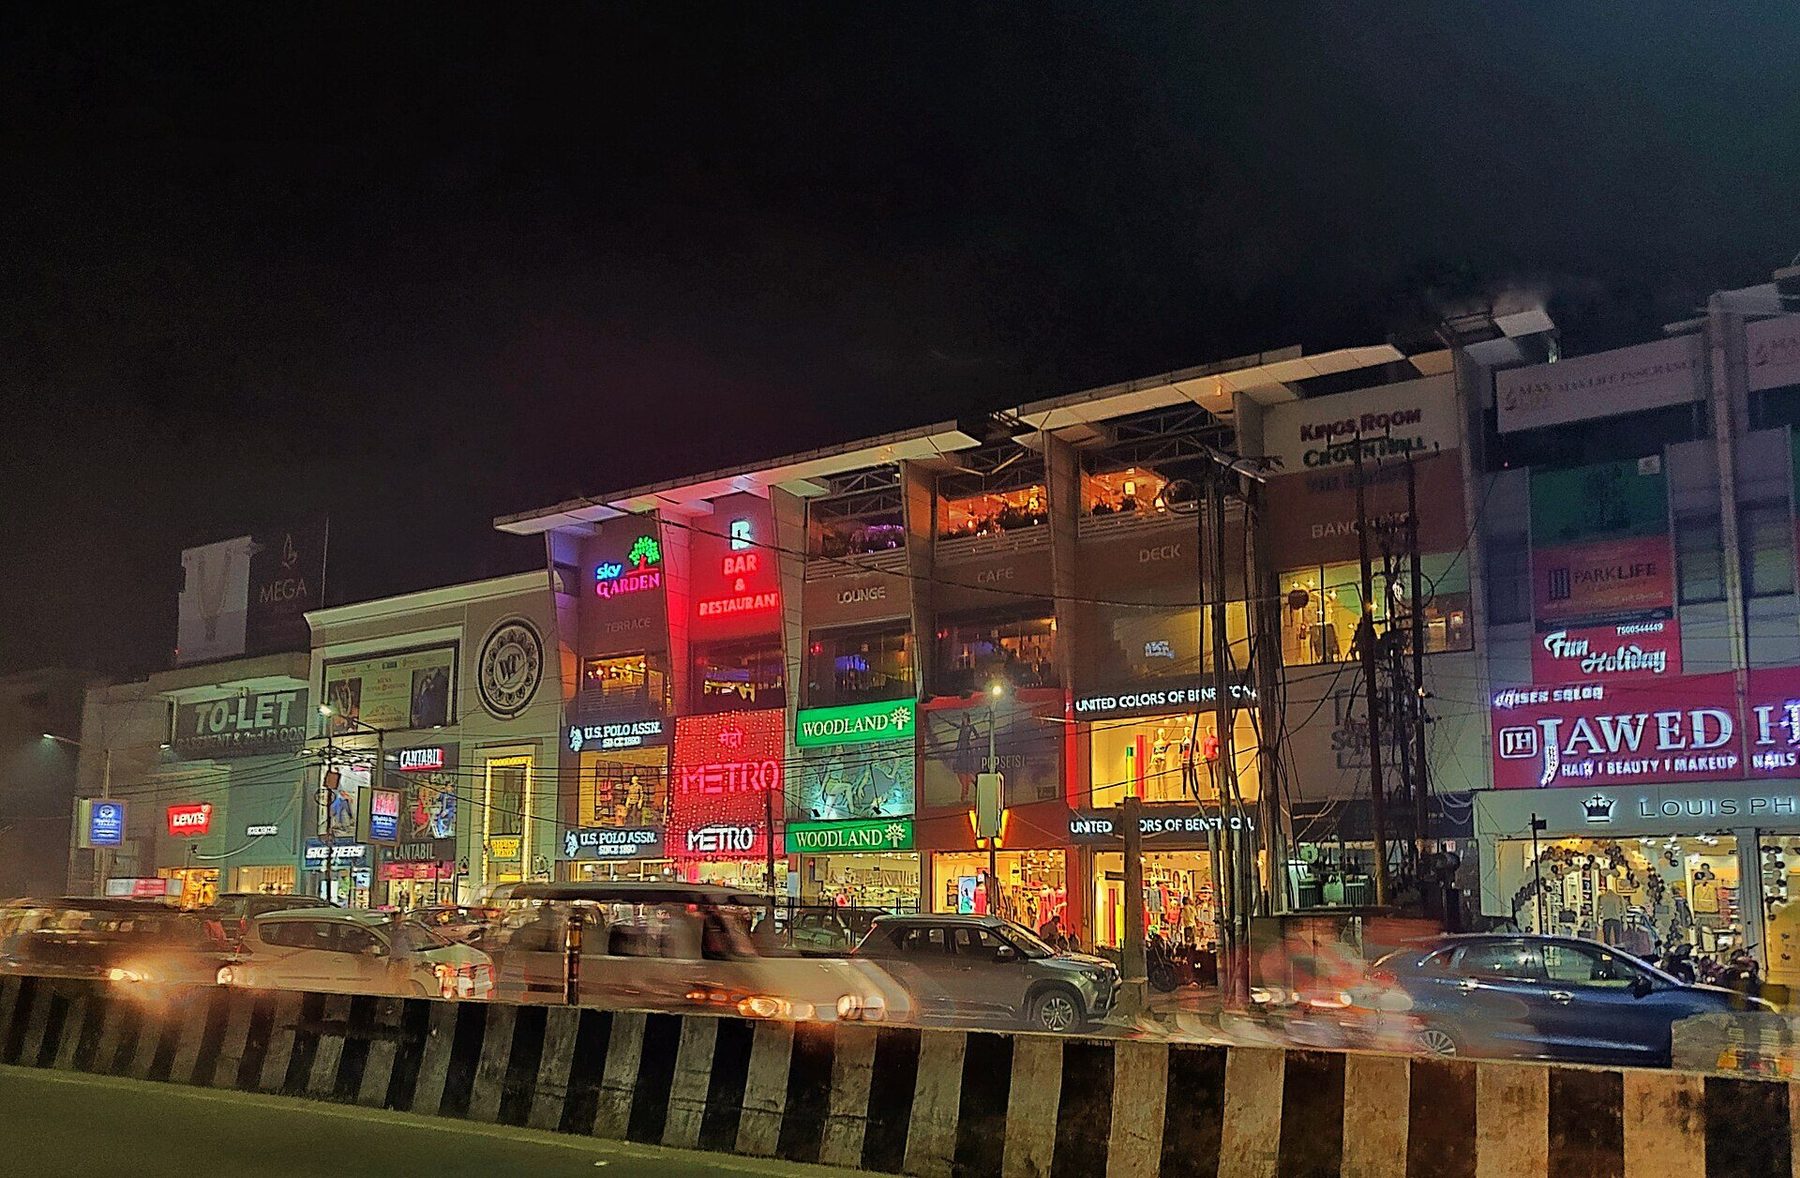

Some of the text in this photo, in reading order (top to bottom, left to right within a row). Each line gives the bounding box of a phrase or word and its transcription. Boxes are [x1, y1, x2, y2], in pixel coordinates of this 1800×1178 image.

[1360, 408, 1421, 433] ROOM
[1140, 543, 1181, 562] DECK
[724, 554, 758, 575] BAR
[597, 573, 660, 598] GARDEN
[735, 577, 745, 591] &
[977, 568, 1014, 583] CAFE
[260, 579, 307, 603] MEGA
[838, 586, 886, 604] LOUNGE
[605, 618, 651, 633] TERRACE
[1544, 631, 1588, 659] Fun
[1581, 645, 1666, 673] Holiday
[1076, 698, 1117, 711] UNITED
[1119, 692, 1166, 708] COLORS
[1167, 690, 1186, 704] OF
[195, 691, 298, 735] TO-LET
[584, 721, 662, 740] U.S. POLO ASSN.
[803, 714, 889, 738] WOODLAND
[1506, 732, 1531, 754] JH
[1537, 710, 1733, 787] JAWED
[400, 748, 443, 768] CANTABIL
[1562, 753, 1797, 779] HAIR BEAUTY MAKEUP NAILS
[682, 760, 780, 795] METRO
[1640, 799, 1738, 817] LOUIS
[1070, 820, 1113, 834] UNITED
[1165, 818, 1183, 832] OF
[580, 830, 658, 846] U.S. POLO ASSN.
[687, 827, 754, 851] METRO
[796, 829, 883, 847] WOODLAND
[394, 842, 436, 860] CANTABIL
